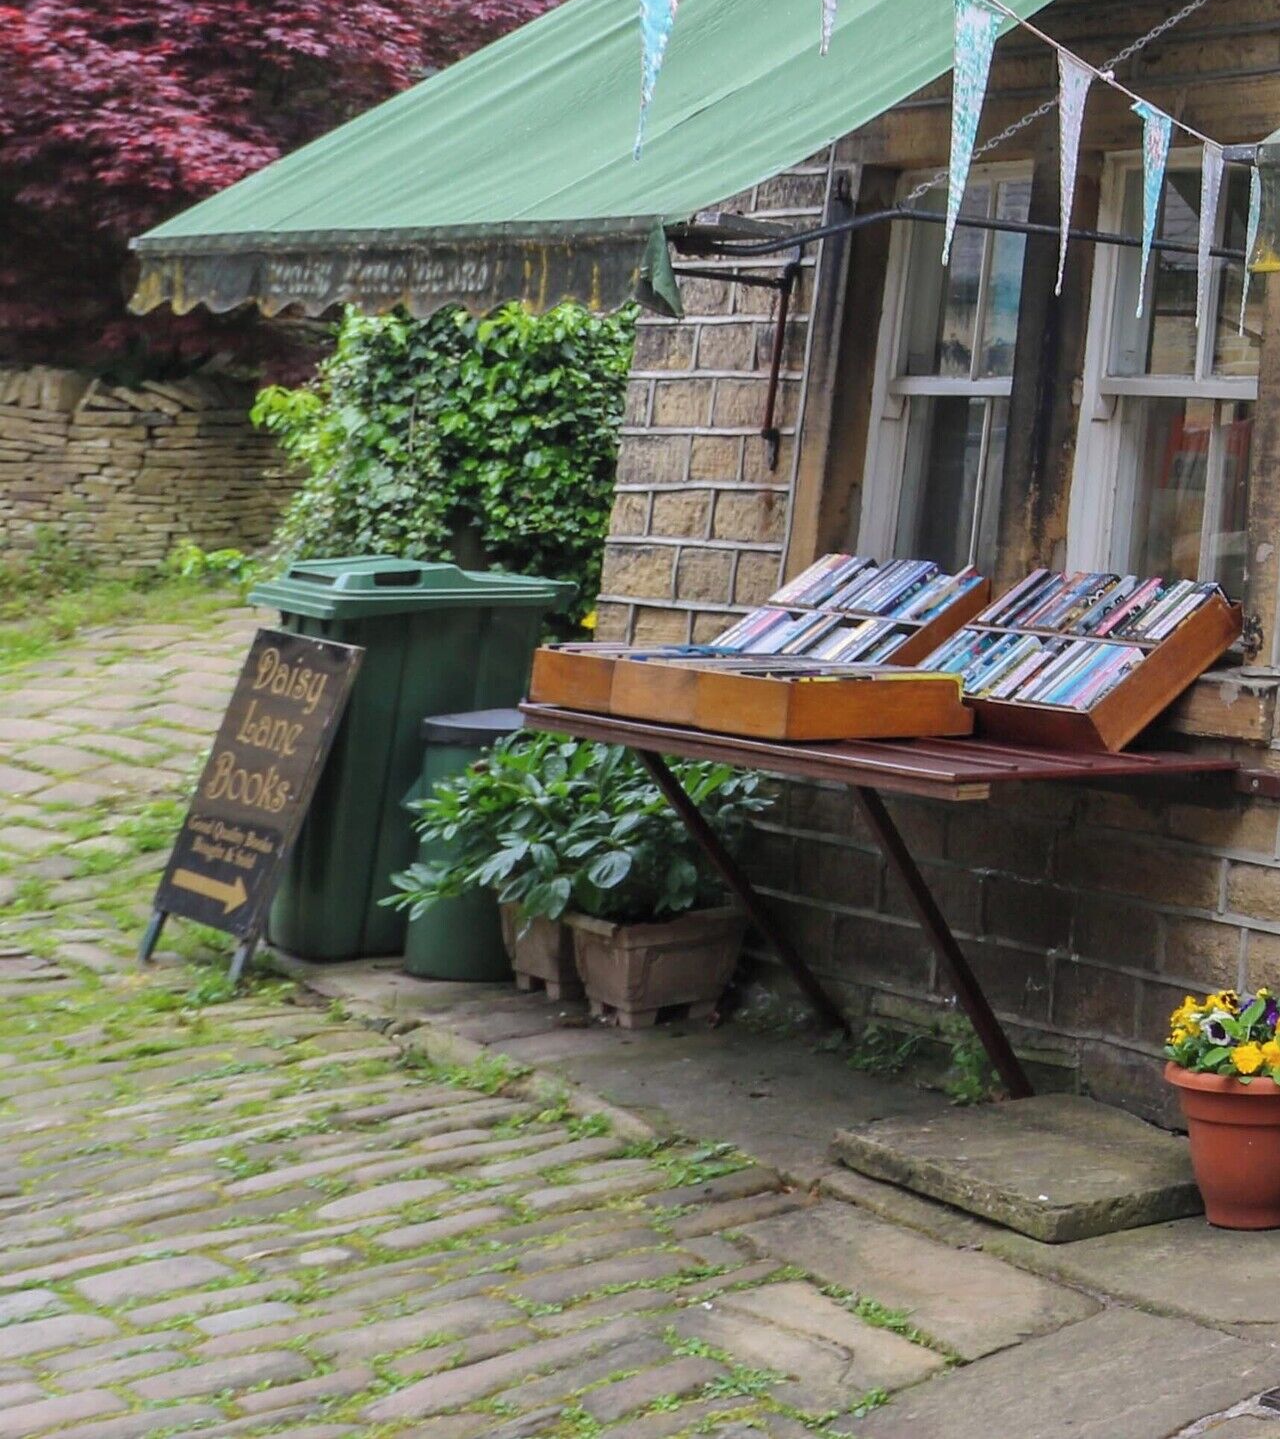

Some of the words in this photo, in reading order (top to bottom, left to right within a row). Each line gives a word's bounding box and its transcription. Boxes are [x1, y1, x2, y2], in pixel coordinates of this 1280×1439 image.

[254, 647, 329, 714] Daisy
[236, 701, 305, 760] Lane
[205, 751, 291, 812] Books
